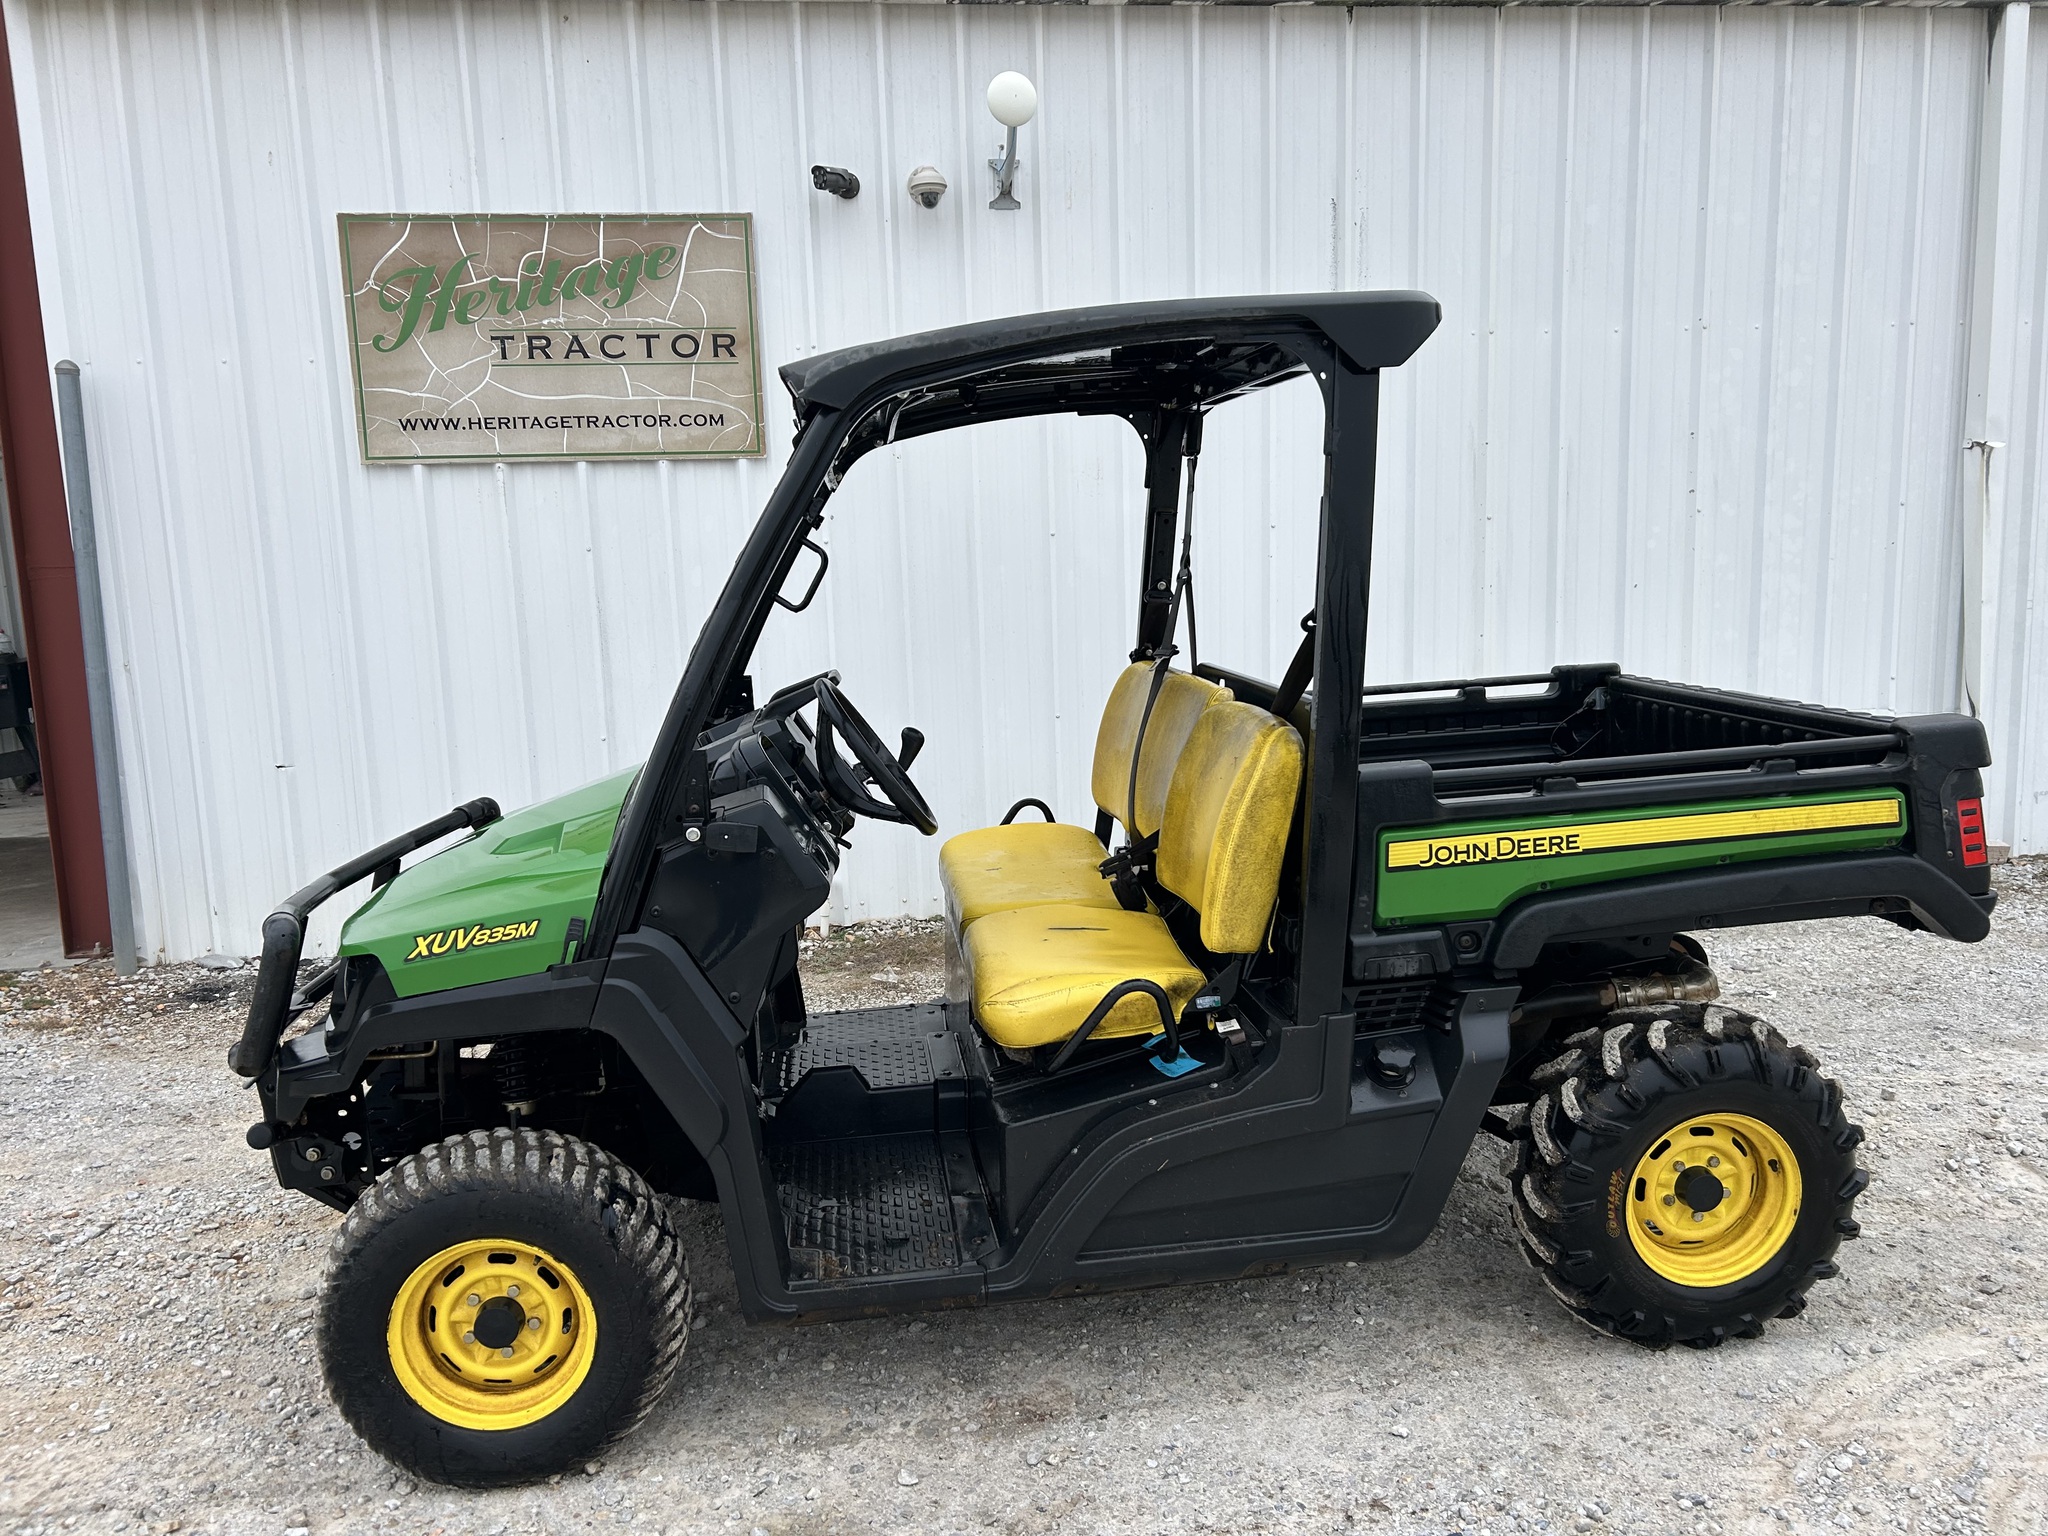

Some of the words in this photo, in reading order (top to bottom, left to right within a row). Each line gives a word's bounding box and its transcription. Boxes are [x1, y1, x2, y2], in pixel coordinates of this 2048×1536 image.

[372, 245, 682, 353] Heritage
[490, 332, 737, 361] TRACTOR
[398, 413, 725, 432] WWW.HERITAGETRACTOR.COM
[1419, 842, 1489, 864] JOHN
[1496, 833, 1580, 857] DEERE
[405, 919, 540, 961] XUV835M
